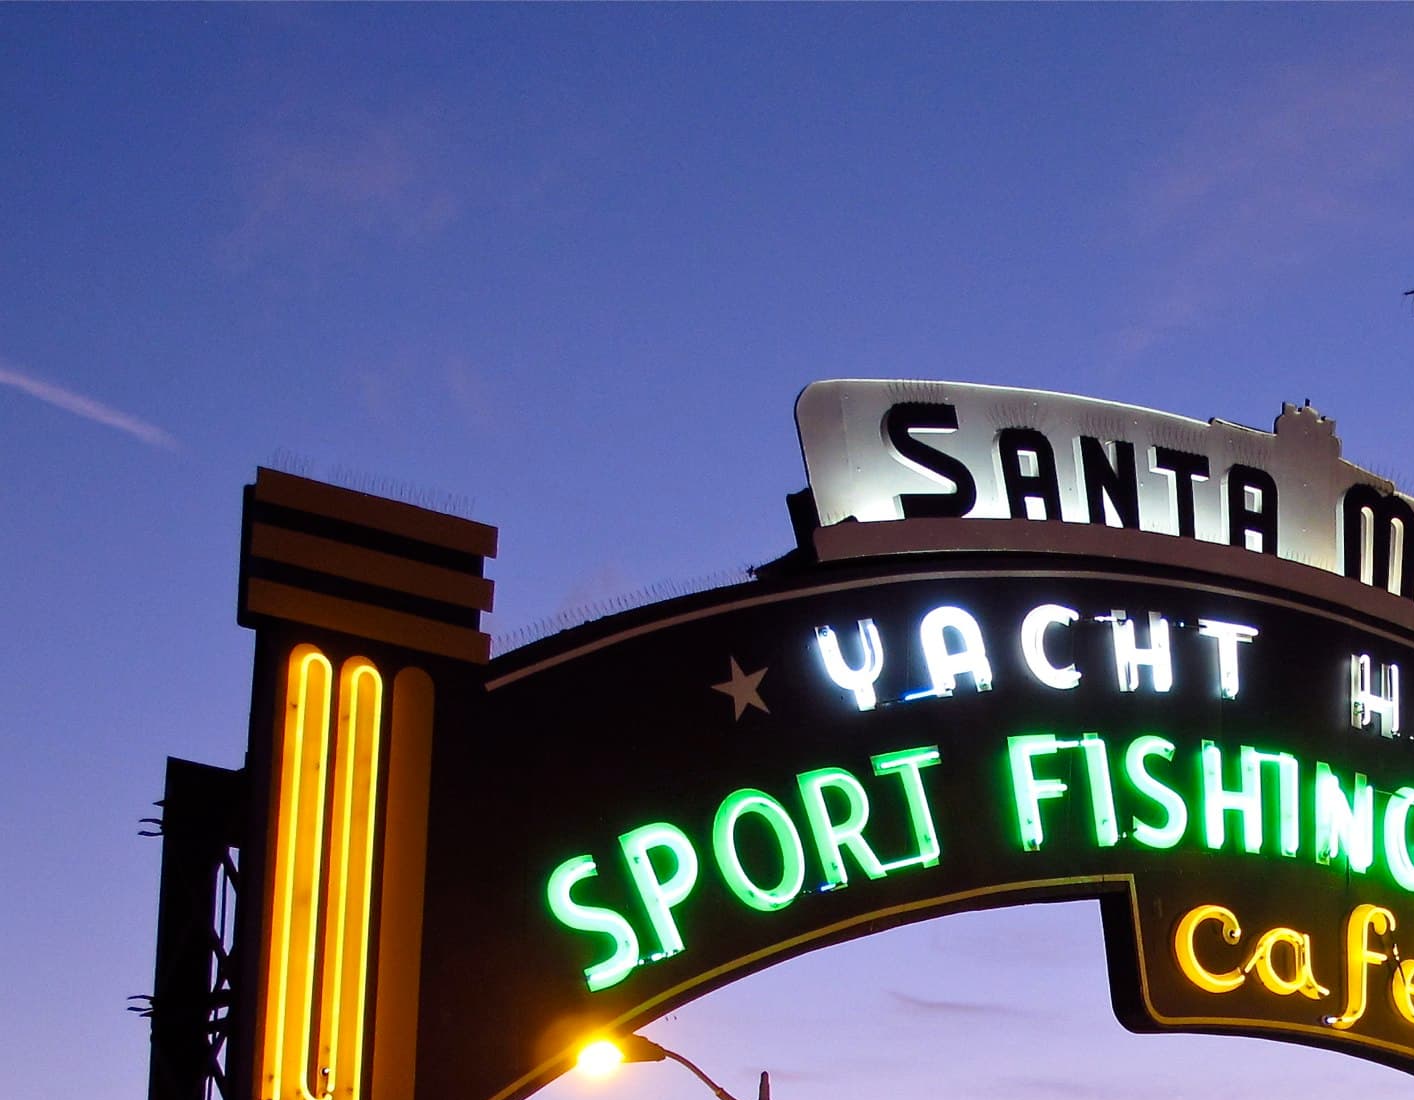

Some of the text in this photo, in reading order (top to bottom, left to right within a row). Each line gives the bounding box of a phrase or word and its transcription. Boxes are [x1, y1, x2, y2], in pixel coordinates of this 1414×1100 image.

[881, 402, 1278, 555] SANTA
[815, 604, 1258, 711] YACHT
[547, 745, 941, 992] SPORT
